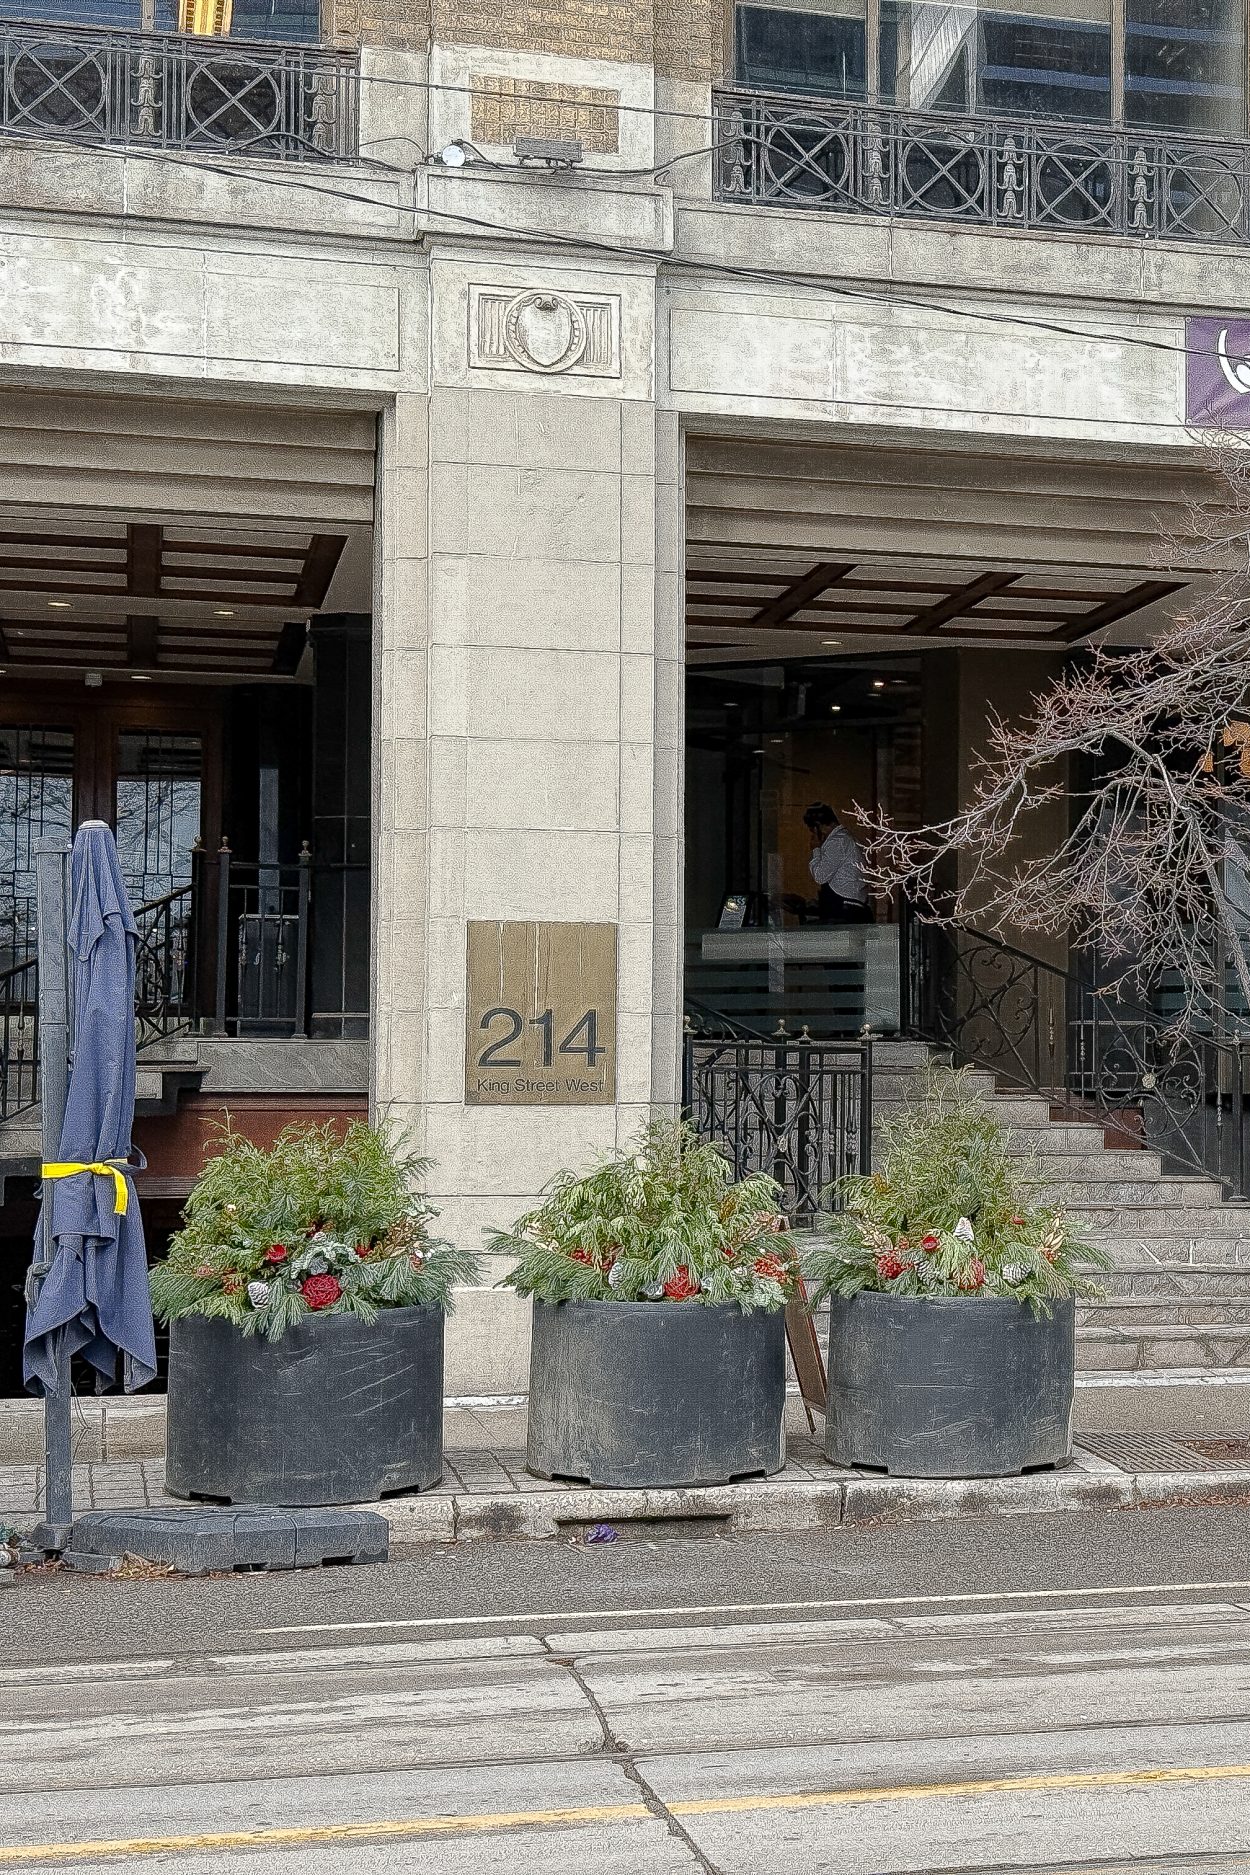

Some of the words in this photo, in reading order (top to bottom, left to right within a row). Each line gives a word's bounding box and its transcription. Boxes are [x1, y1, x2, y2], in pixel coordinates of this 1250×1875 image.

[477, 1007, 606, 1068] 214
[477, 1078, 511, 1095] King
[514, 1078, 560, 1093] Street
[566, 1078, 604, 1093] West
